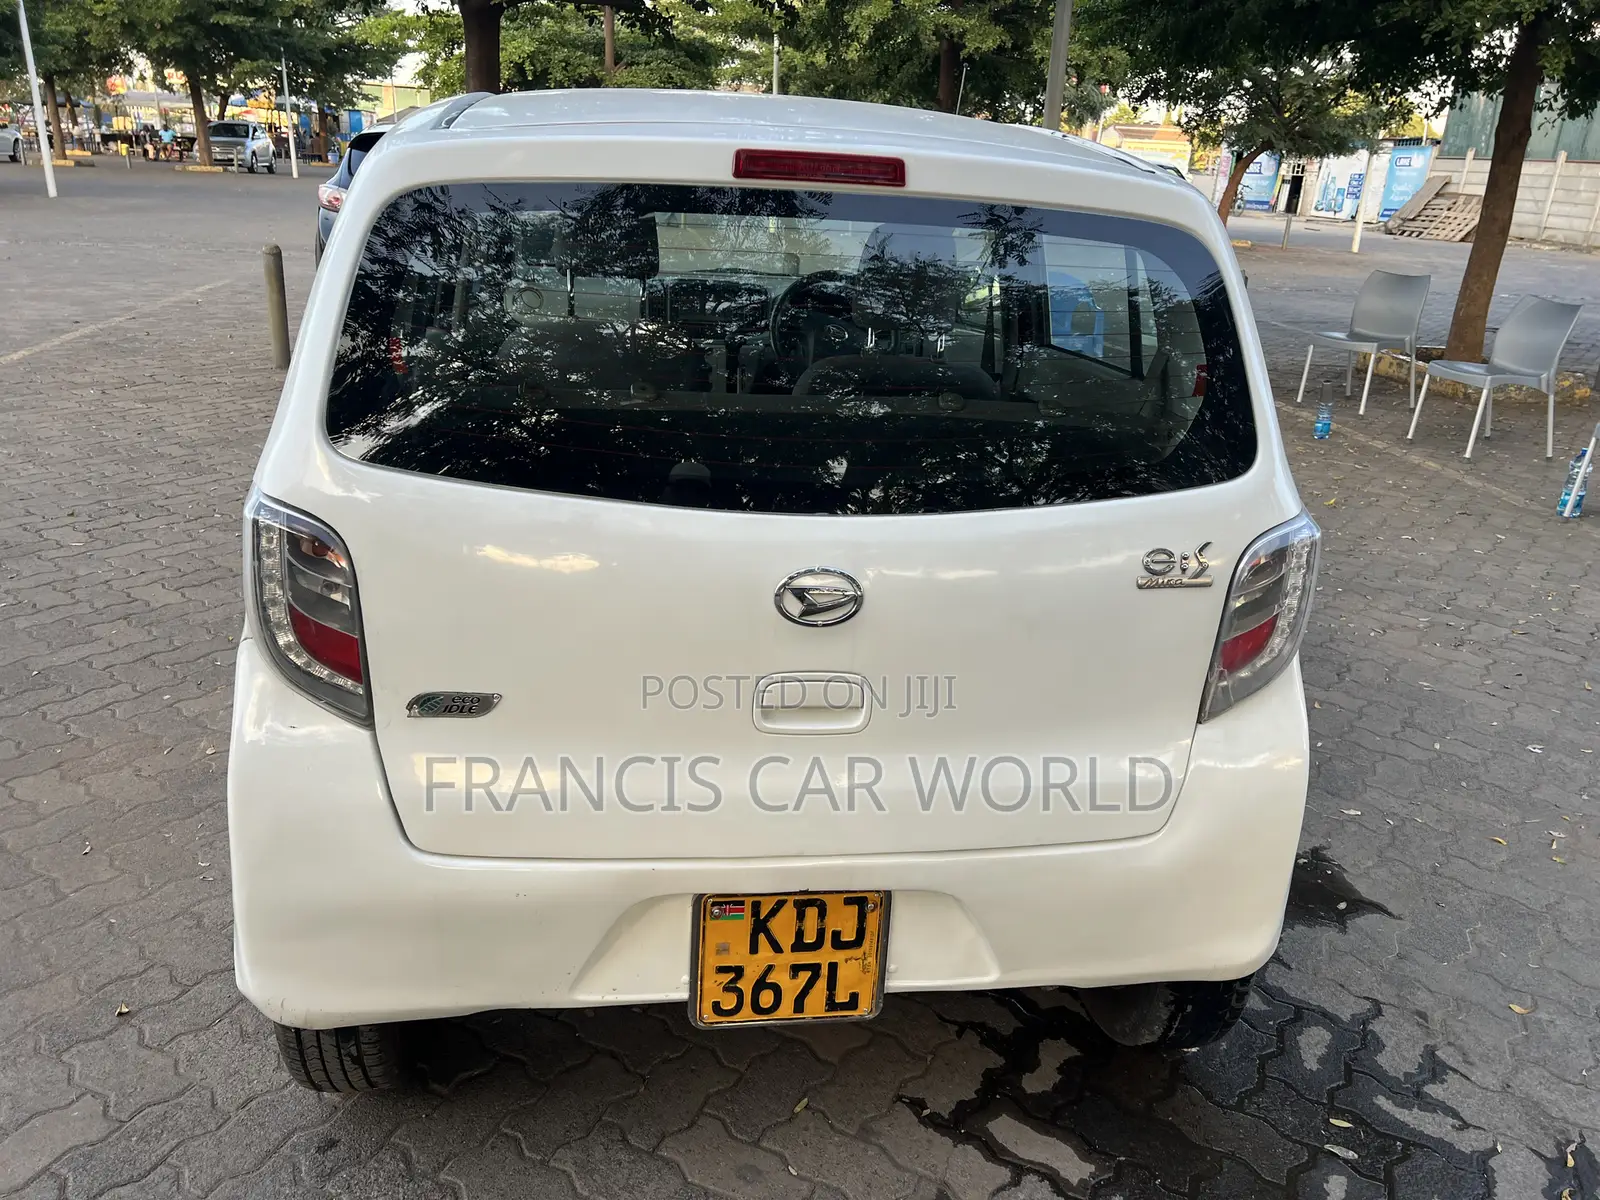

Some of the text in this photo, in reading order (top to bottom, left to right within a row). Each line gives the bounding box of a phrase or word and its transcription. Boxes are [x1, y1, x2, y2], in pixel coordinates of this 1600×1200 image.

[442, 704, 479, 714] IDLE
[452, 695, 481, 704] eco
[749, 896, 869, 954] KDJ
[711, 962, 860, 1017] 367L
